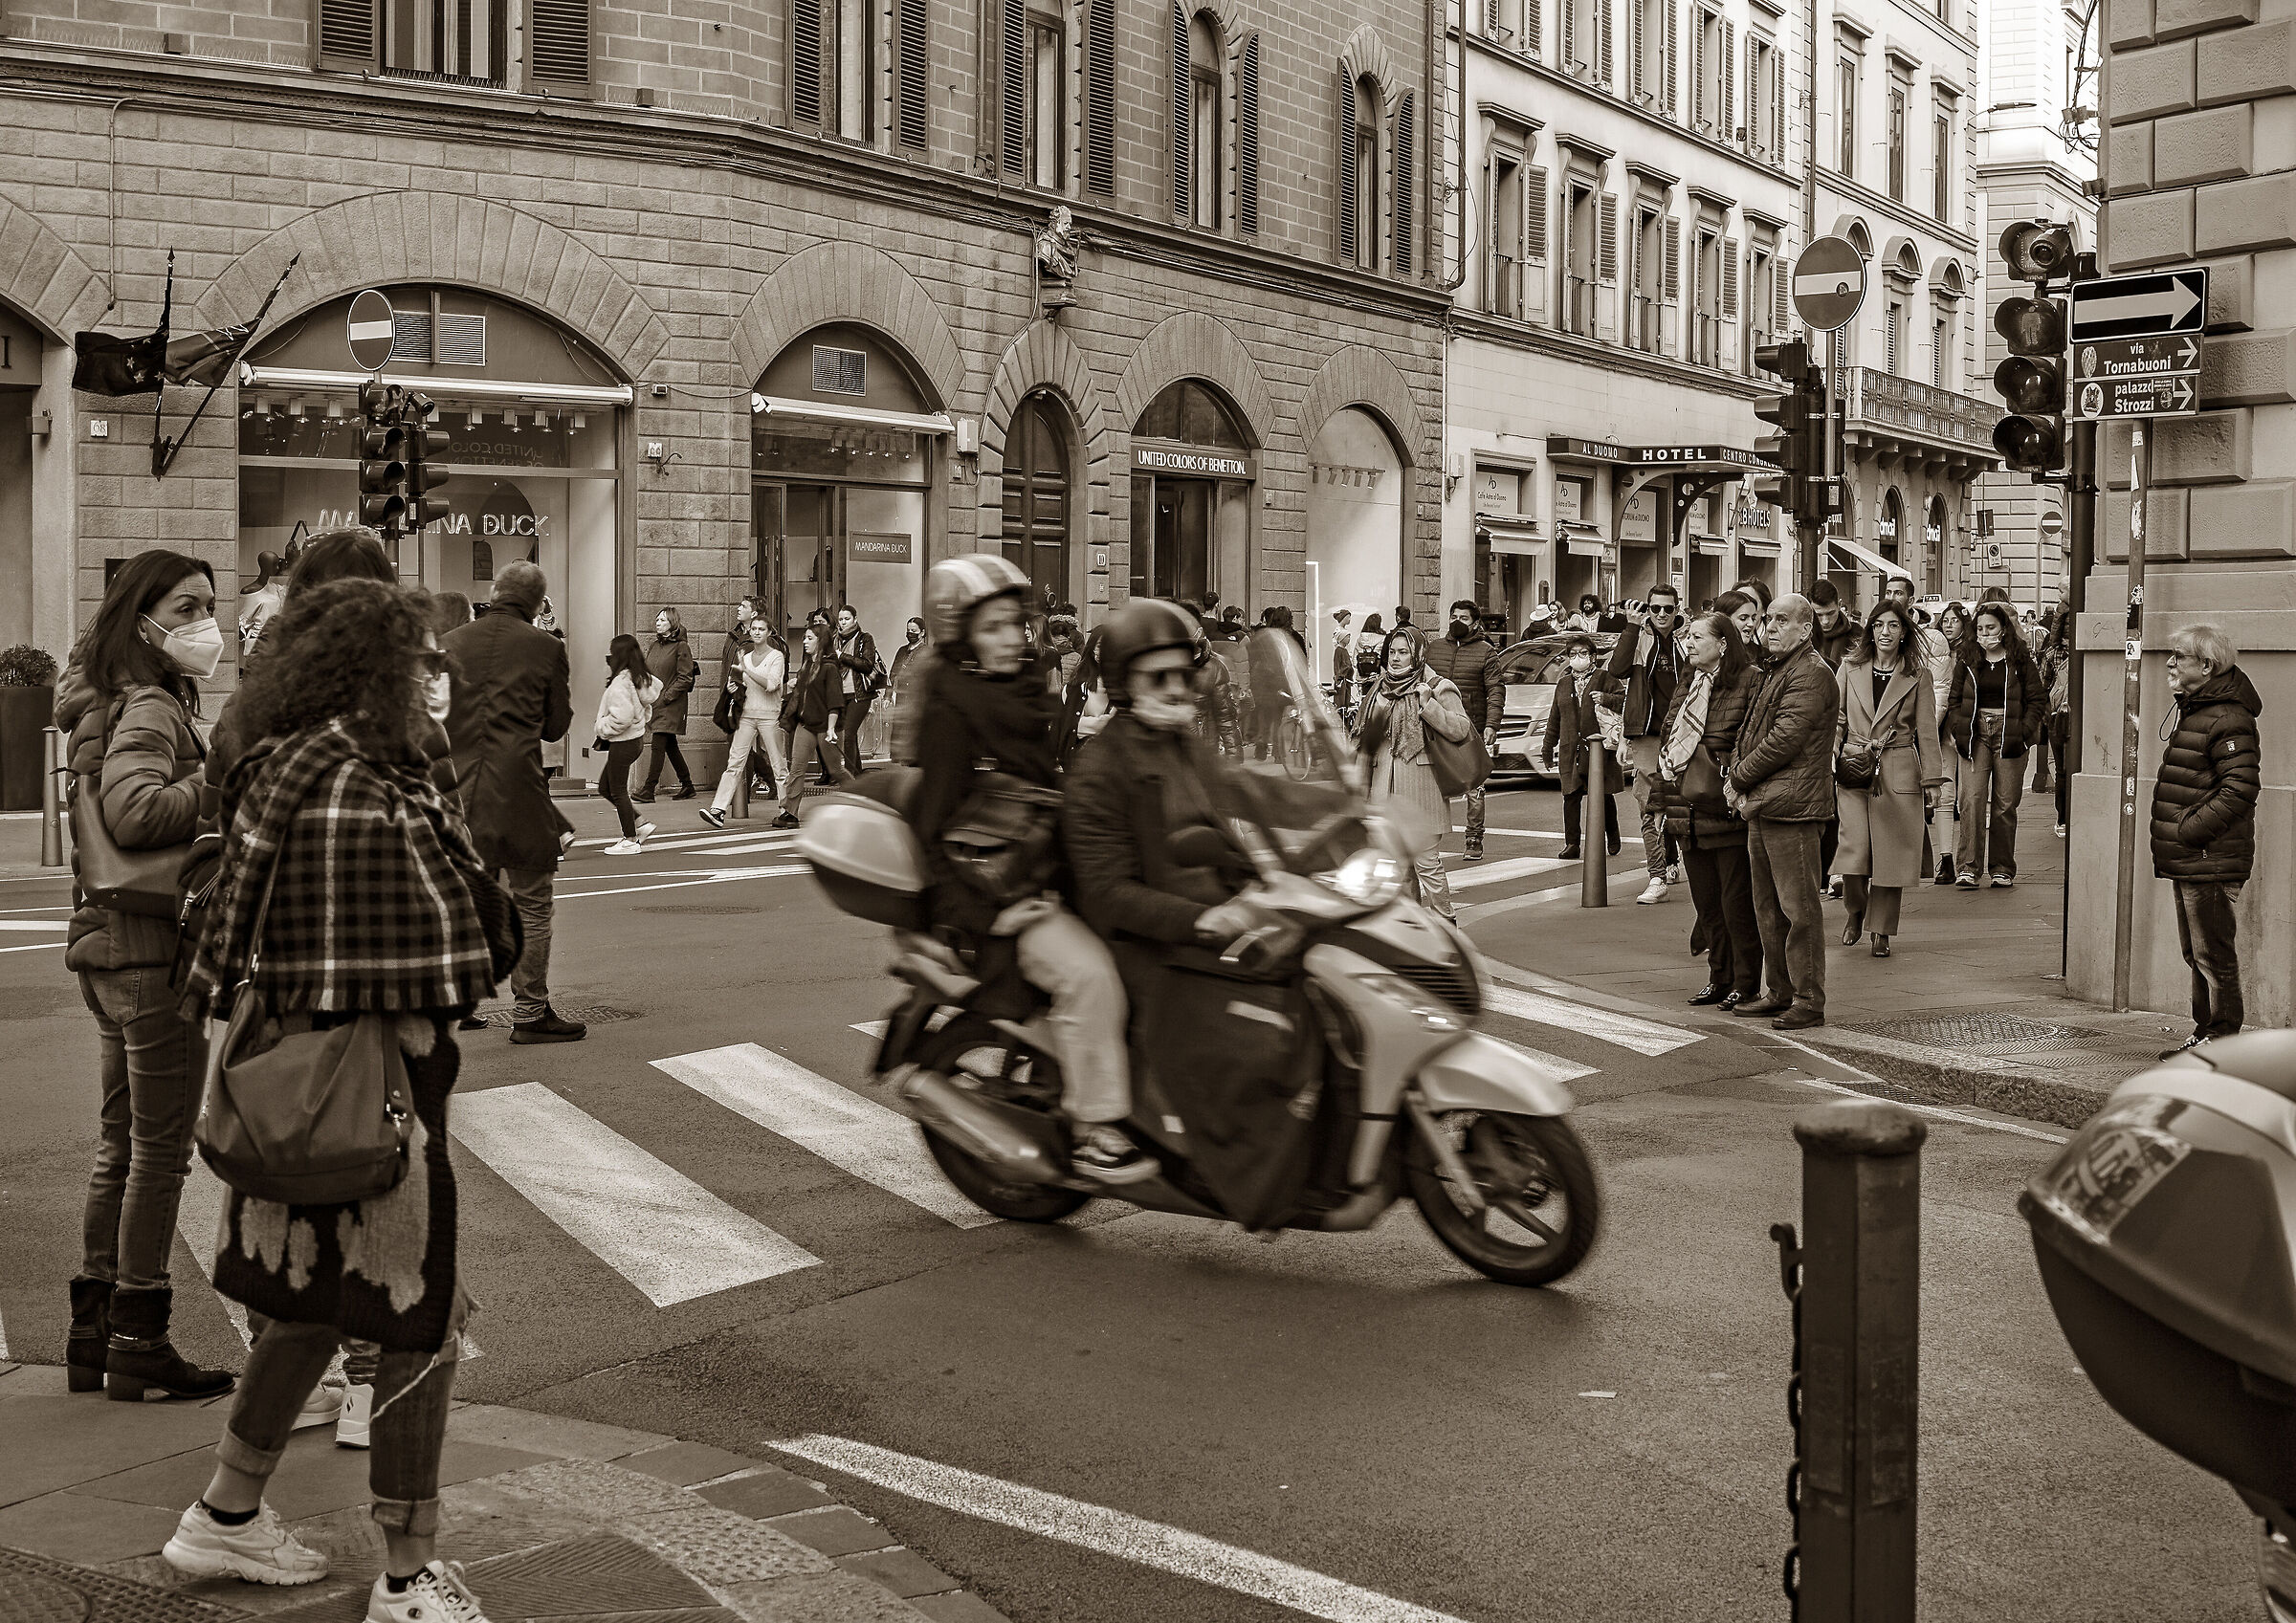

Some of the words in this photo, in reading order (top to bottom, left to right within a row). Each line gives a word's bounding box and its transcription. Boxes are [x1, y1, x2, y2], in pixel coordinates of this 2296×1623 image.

[2130, 342, 2145, 355] via
[2104, 355, 2172, 375] Tornabuoni
[2113, 397, 2154, 413] Strozzi
[1582, 443, 1592, 455] AL
[1594, 445, 1619, 459] DUOMO
[1642, 449, 1707, 461] HOTEL
[1722, 449, 1747, 464] CENTRO
[1137, 450, 1166, 467] UNITED
[1167, 453, 1197, 470] COLORS
[1198, 456, 1208, 471] OF
[482, 514, 550, 536] DUCK
[854, 541, 891, 553] MANDARINA
[891, 543, 908, 554] DUCK
